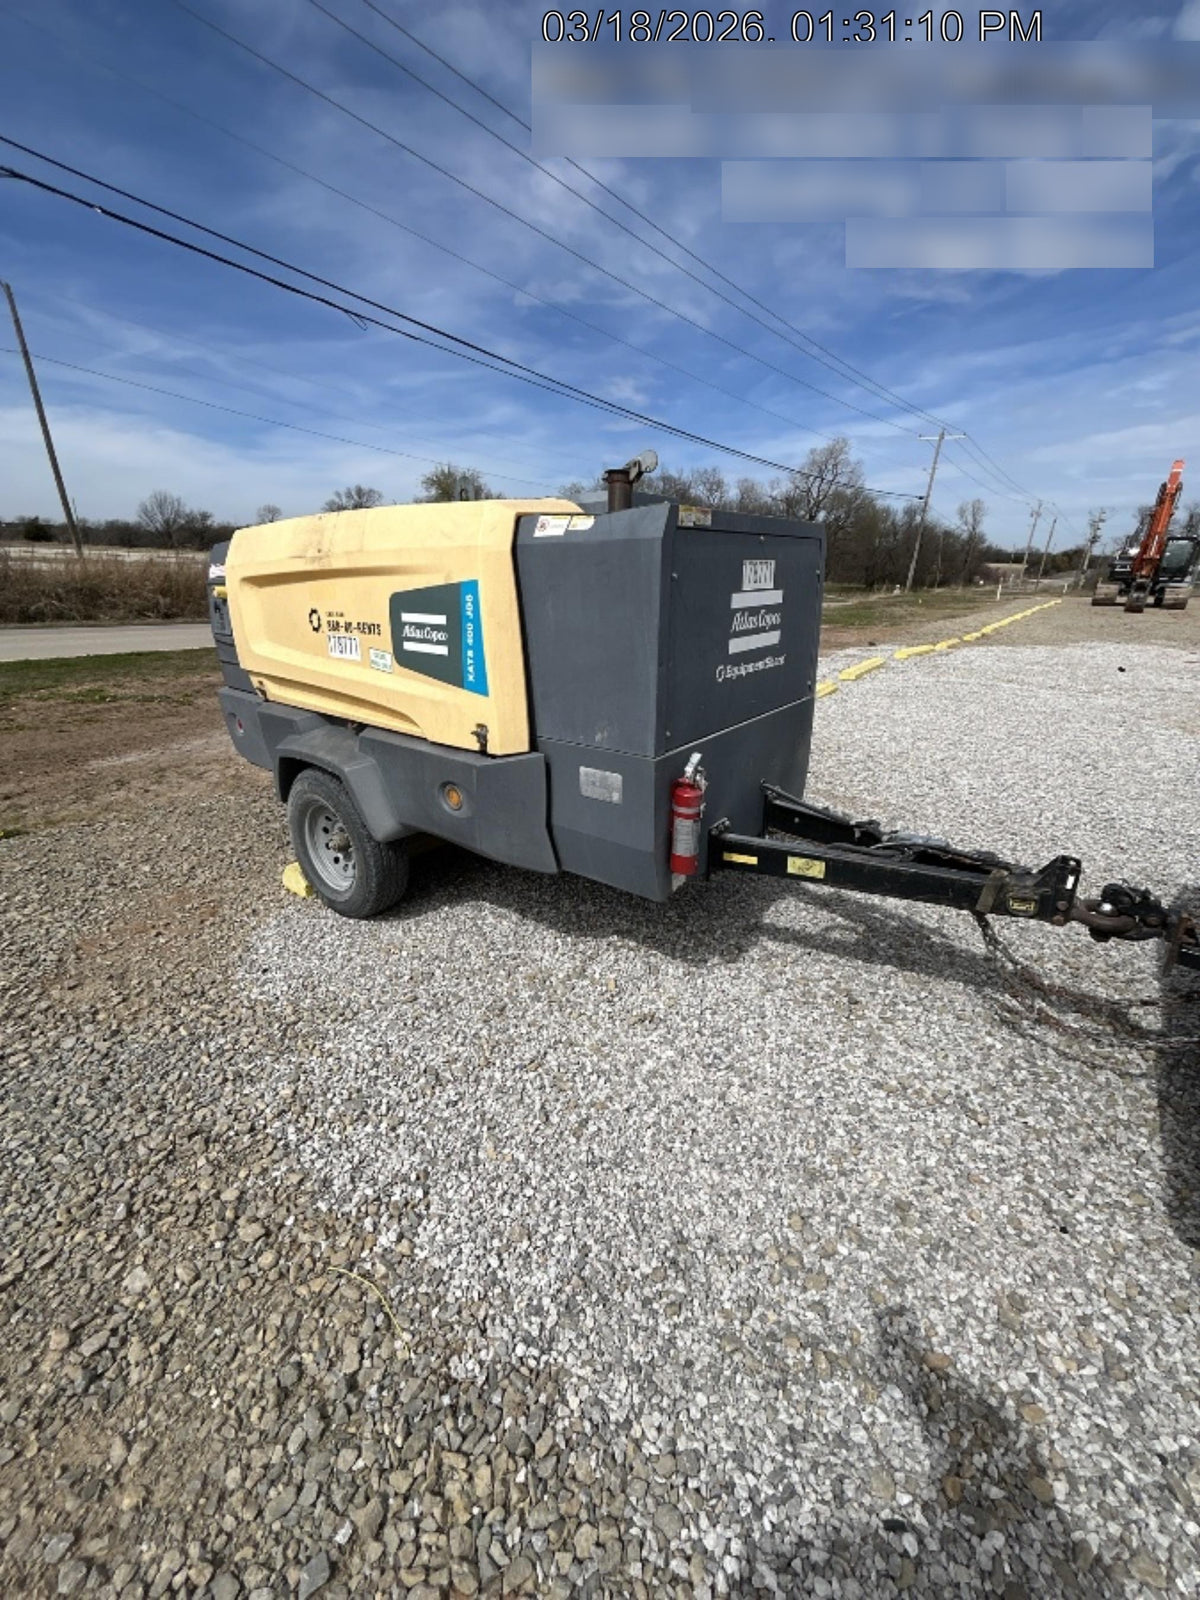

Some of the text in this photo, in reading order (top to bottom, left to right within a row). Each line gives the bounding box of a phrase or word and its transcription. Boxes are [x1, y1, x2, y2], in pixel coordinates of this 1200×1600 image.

[731, 609, 781, 632] Atlas Copco
[402, 625, 448, 643] Atlas Copco
[466, 622, 474, 646] 400
[466, 649, 475, 682] XATS
